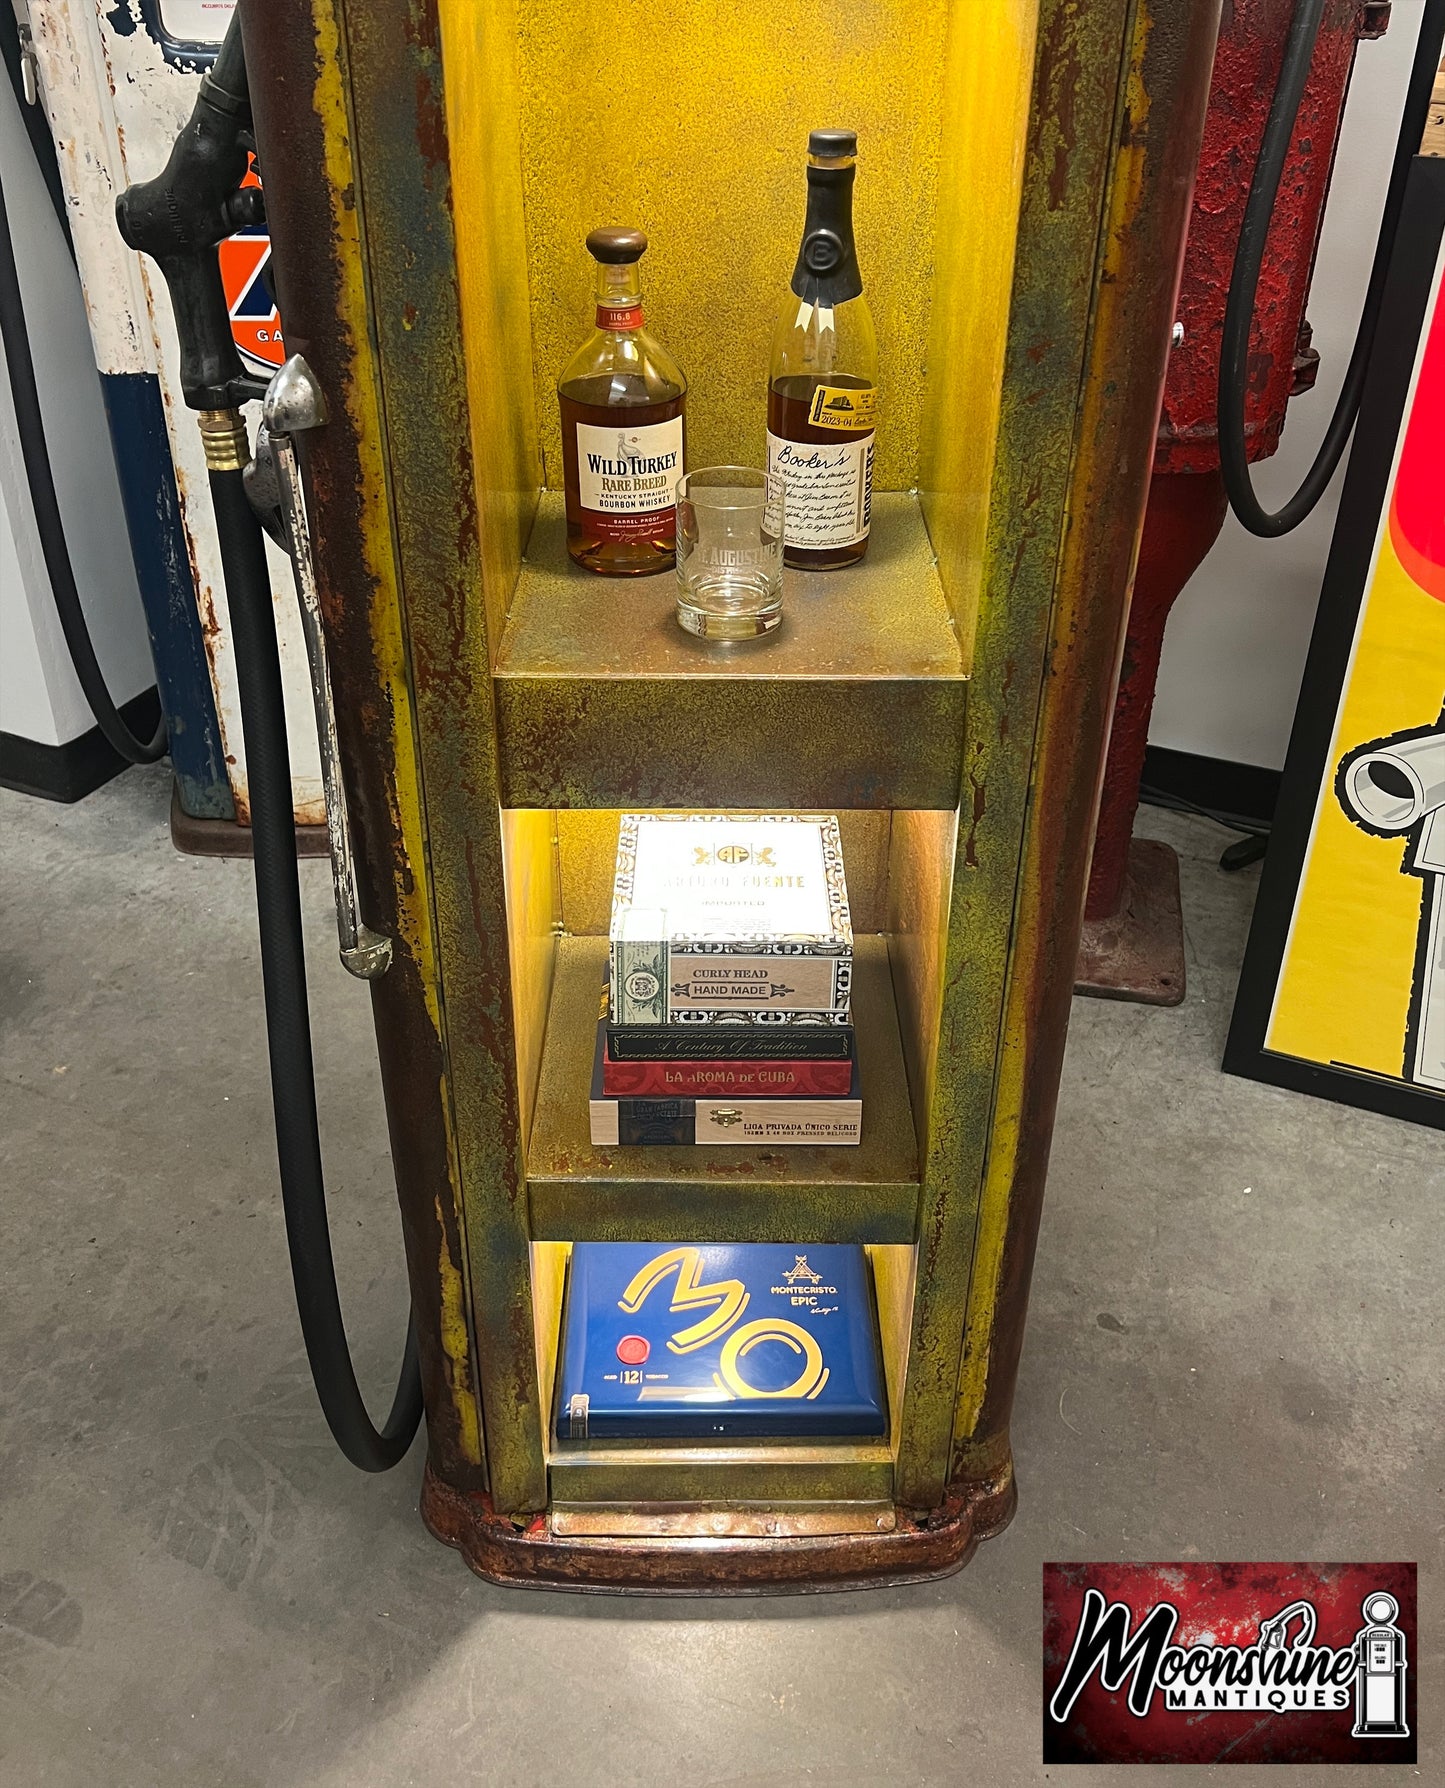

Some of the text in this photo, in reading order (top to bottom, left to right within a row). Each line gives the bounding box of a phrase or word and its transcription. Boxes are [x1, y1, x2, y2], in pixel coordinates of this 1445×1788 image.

[610, 312, 631, 321] 116.8
[777, 445, 851, 469] Booker's
[587, 451, 678, 476] WILD TURKEY
[601, 475, 667, 492] RARE BREED
[639, 488, 669, 499] STRAIGHT
[599, 495, 671, 508] BOURBON WHISKEY
[717, 845, 750, 864] AF
[742, 875, 806, 888] FUENTE
[692, 969, 768, 979] CURLY HEAD
[693, 985, 766, 995] HAND MADE
[655, 1039, 808, 1054] A Century Of Tradition
[665, 1071, 683, 1083] LA
[687, 1071, 736, 1083] AROMA
[758, 1071, 795, 1083] CUBA
[743, 1121, 858, 1131] LIGA PRIVADA ÚNICO SERIE
[770, 1286, 837, 1294] MONTECRISTO
[790, 1296, 818, 1306] EPIC
[624, 1370, 640, 1384] 12
